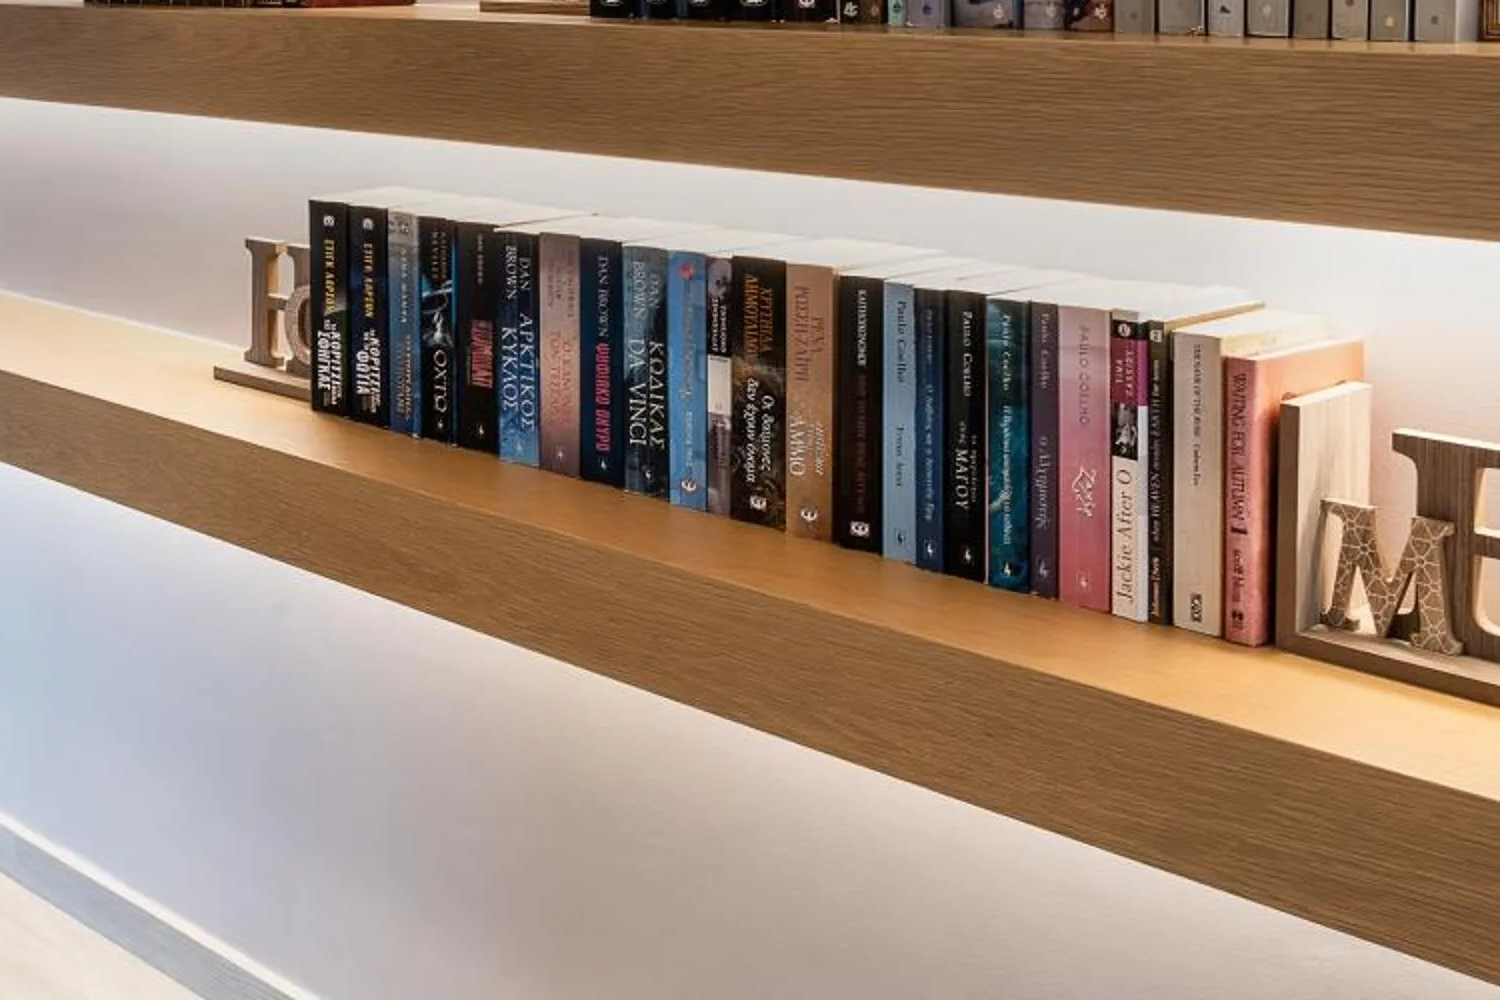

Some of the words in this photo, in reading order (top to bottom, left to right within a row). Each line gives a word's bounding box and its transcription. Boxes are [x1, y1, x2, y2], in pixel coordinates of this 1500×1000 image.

[505, 245, 519, 300] BROWN
[519, 257, 532, 291] DAN
[598, 256, 609, 283] DAN
[632, 260, 647, 317] BROWN
[649, 273, 660, 309] DAN
[598, 289, 610, 337] BROWN
[897, 299, 907, 335] Paulo
[356, 350, 371, 395] ΦΩΤΙΑ
[501, 327, 519, 411] ΚΥΚΛΟΣ
[518, 313, 536, 433] ΑΡΚΤΙΚΟΣ
[629, 339, 647, 369] DA
[897, 339, 908, 383] Coelho
[1078, 326, 1090, 368] PAULO
[433, 349, 448, 413] ΟΧΤΩ
[649, 341, 665, 450] ΚΩΔΙΚΑΣ
[762, 394, 775, 410] Οι
[1078, 372, 1090, 425] COELHO
[1231, 371, 1247, 428] WAITING
[629, 382, 647, 446] VINCI
[1232, 430, 1246, 456] FOR
[955, 448, 969, 510] ΜΑΓΟΥ
[1115, 469, 1132, 486] O
[1231, 462, 1247, 521] AUTUMN
[1115, 490, 1133, 543] After
[1116, 547, 1134, 603] Jackie
